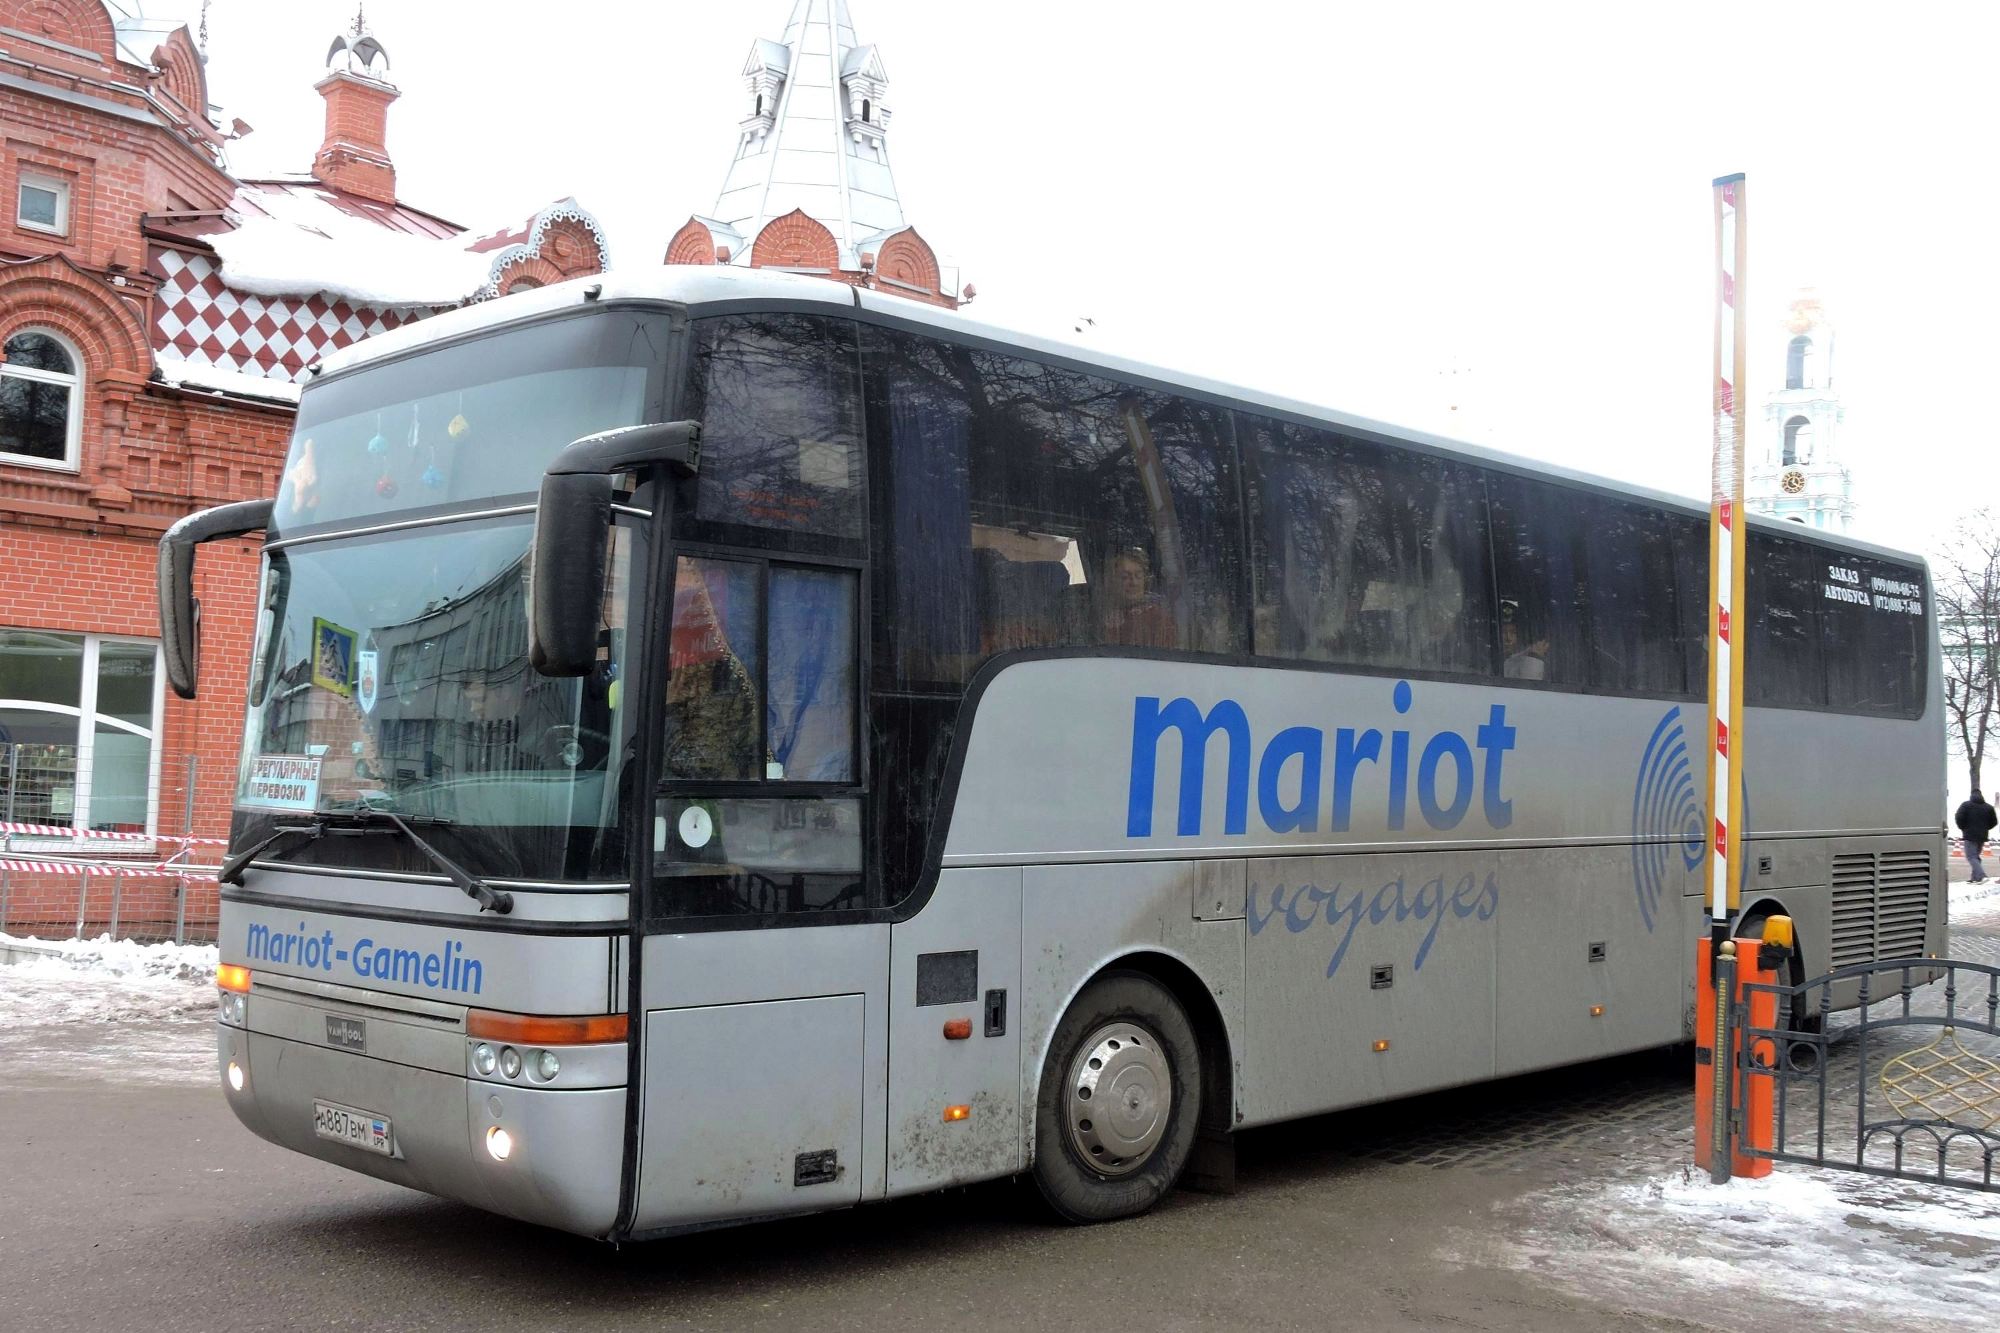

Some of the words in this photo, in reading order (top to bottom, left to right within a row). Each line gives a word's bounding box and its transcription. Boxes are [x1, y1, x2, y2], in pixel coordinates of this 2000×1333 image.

[1824, 584, 1871, 606] АВТОБУСА
[1828, 565, 1860, 584] ЗАКАЗ
[1127, 680, 1517, 838] mariot
[247, 921, 483, 995] mariot-Gamelin
[1242, 870, 1499, 979] voyages
